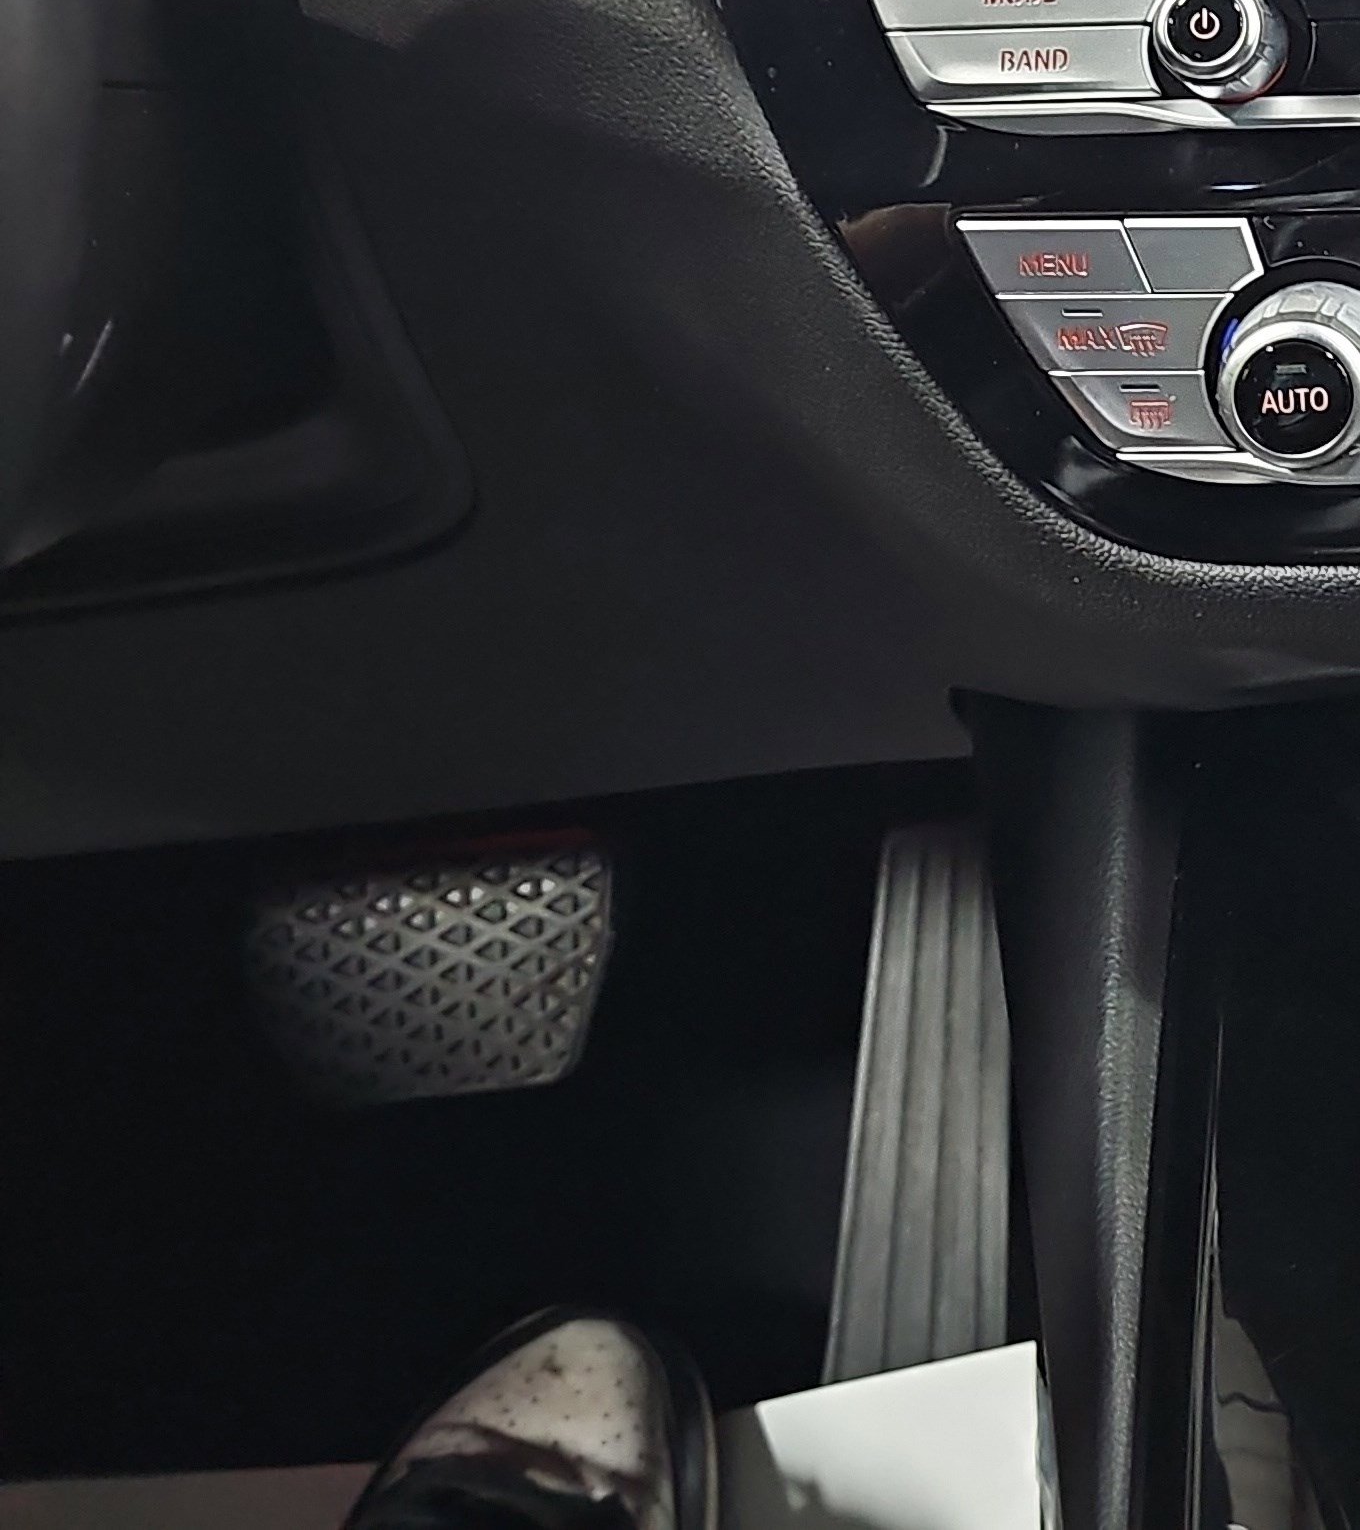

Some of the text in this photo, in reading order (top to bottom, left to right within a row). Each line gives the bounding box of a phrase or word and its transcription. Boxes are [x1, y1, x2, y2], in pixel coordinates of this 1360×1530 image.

[1000, 48, 1069, 72] BAND
[1019, 253, 1089, 277] MENU
[1261, 387, 1329, 415] AUTO
